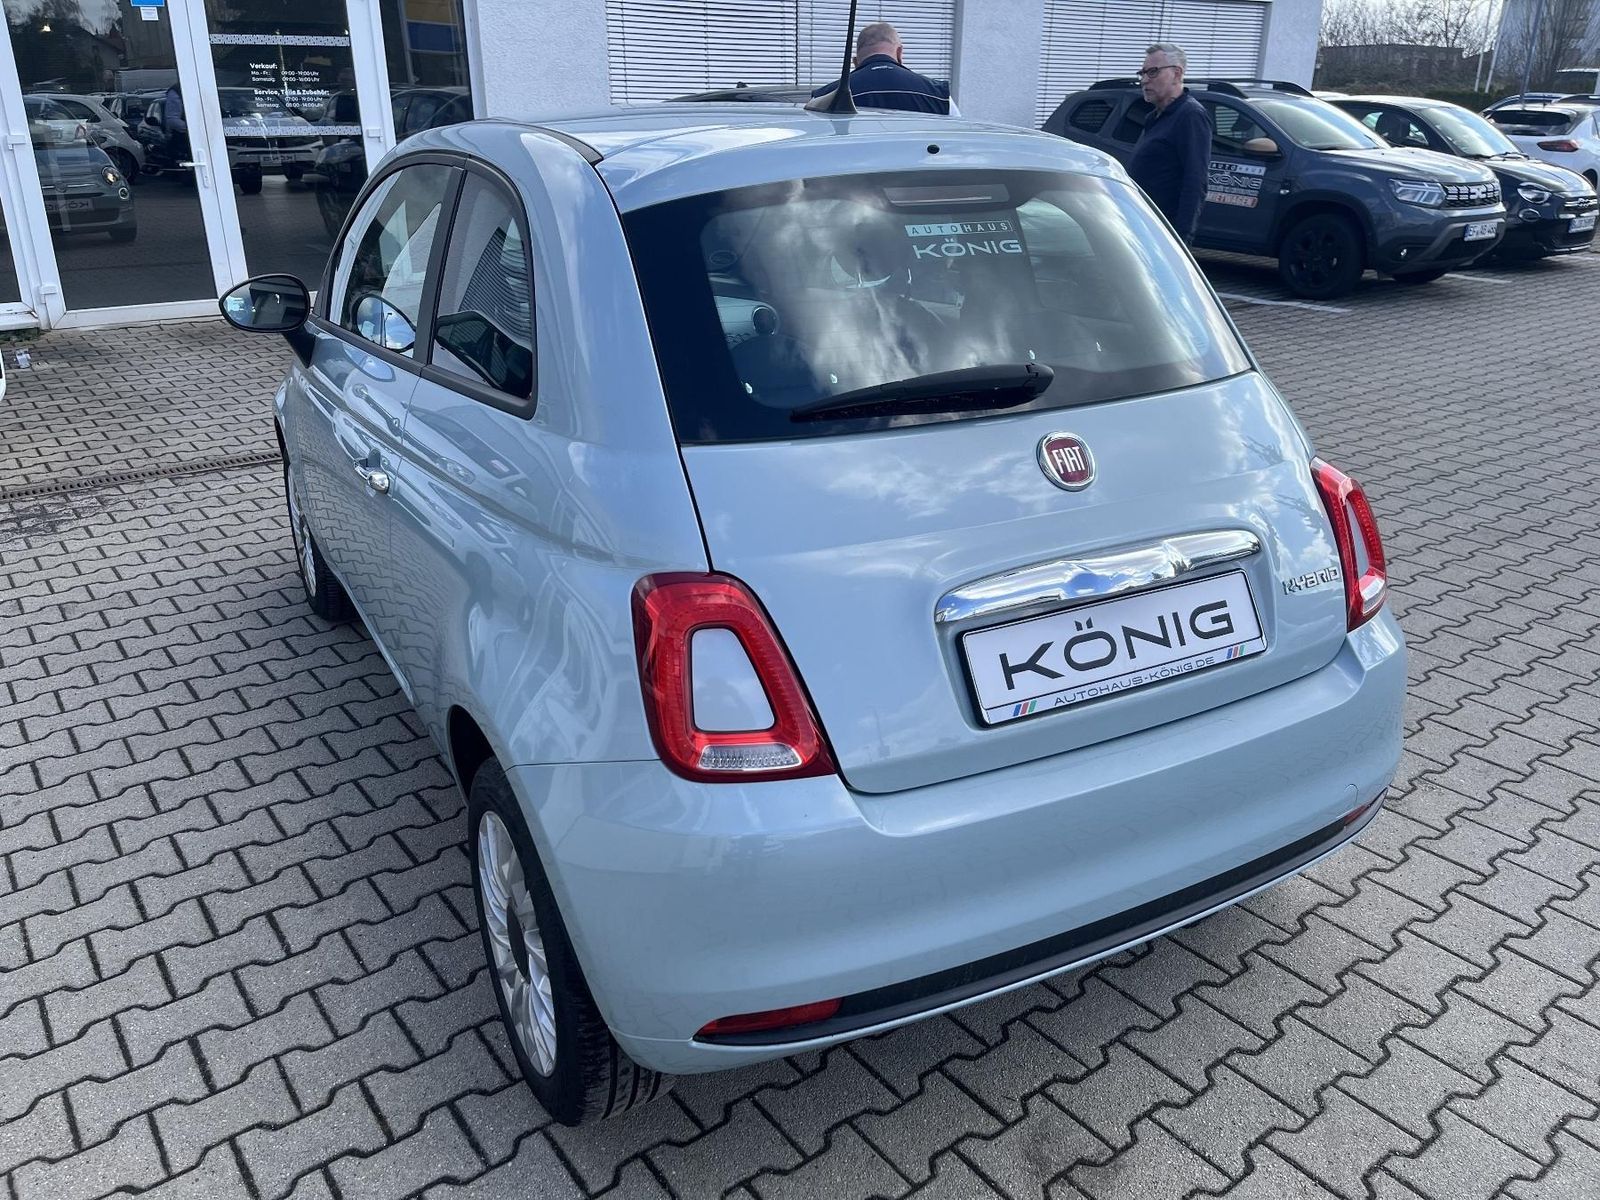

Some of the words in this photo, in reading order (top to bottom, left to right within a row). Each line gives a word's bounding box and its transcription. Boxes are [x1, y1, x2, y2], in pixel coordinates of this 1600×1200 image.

[249, 62, 278, 70] Verkauf:
[911, 221, 1009, 236] AUTOHAUS
[912, 238, 1022, 259] KÖNIG
[1051, 445, 1086, 475] FIAT
[999, 599, 1235, 691] KÖNIG
[1053, 656, 1215, 707] AUTOHAUS-KÖNIG.DE
